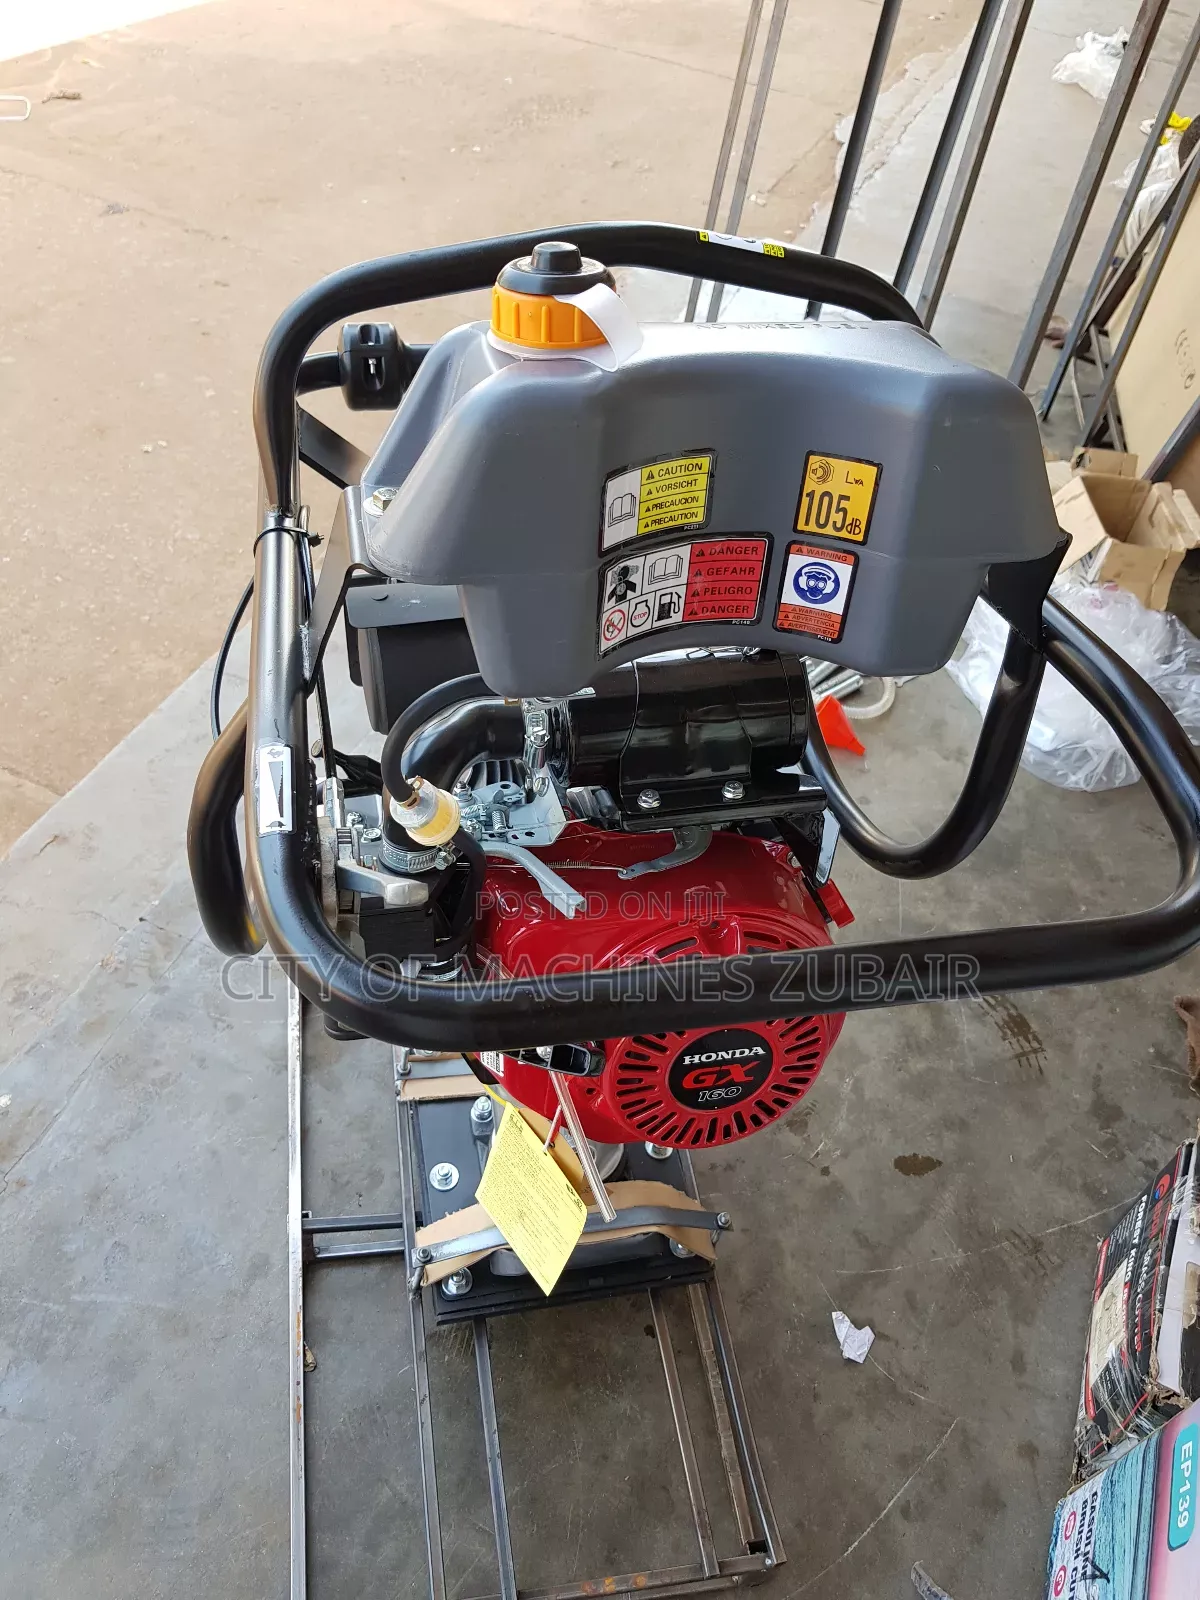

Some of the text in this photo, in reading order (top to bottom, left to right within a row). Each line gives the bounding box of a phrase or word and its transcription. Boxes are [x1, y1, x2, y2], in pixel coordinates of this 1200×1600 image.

[657, 462, 703, 478] CAUTION
[655, 479, 699, 494] VORSICHT
[650, 511, 699, 528] PRECAUTION
[708, 545, 759, 556] DANGER
[806, 547, 848, 562] WARNING
[706, 566, 756, 577] GEFAHR
[703, 586, 753, 597] PELIGRO
[632, 611, 648, 622] STOP
[701, 604, 750, 614] DANGER
[787, 621, 836, 638] AVERTISSEMENT
[791, 614, 835, 629] ADVERTENCIA
[682, 1046, 767, 1065] HONDA
[682, 1061, 761, 1089] GX
[697, 1086, 742, 1102] 160
[1132, 1194, 1148, 1244] FOREST
[1177, 1440, 1193, 1528] EP139
[1073, 1497, 1089, 1560] BRUSH
[1081, 1491, 1099, 1580] GASOLINE
